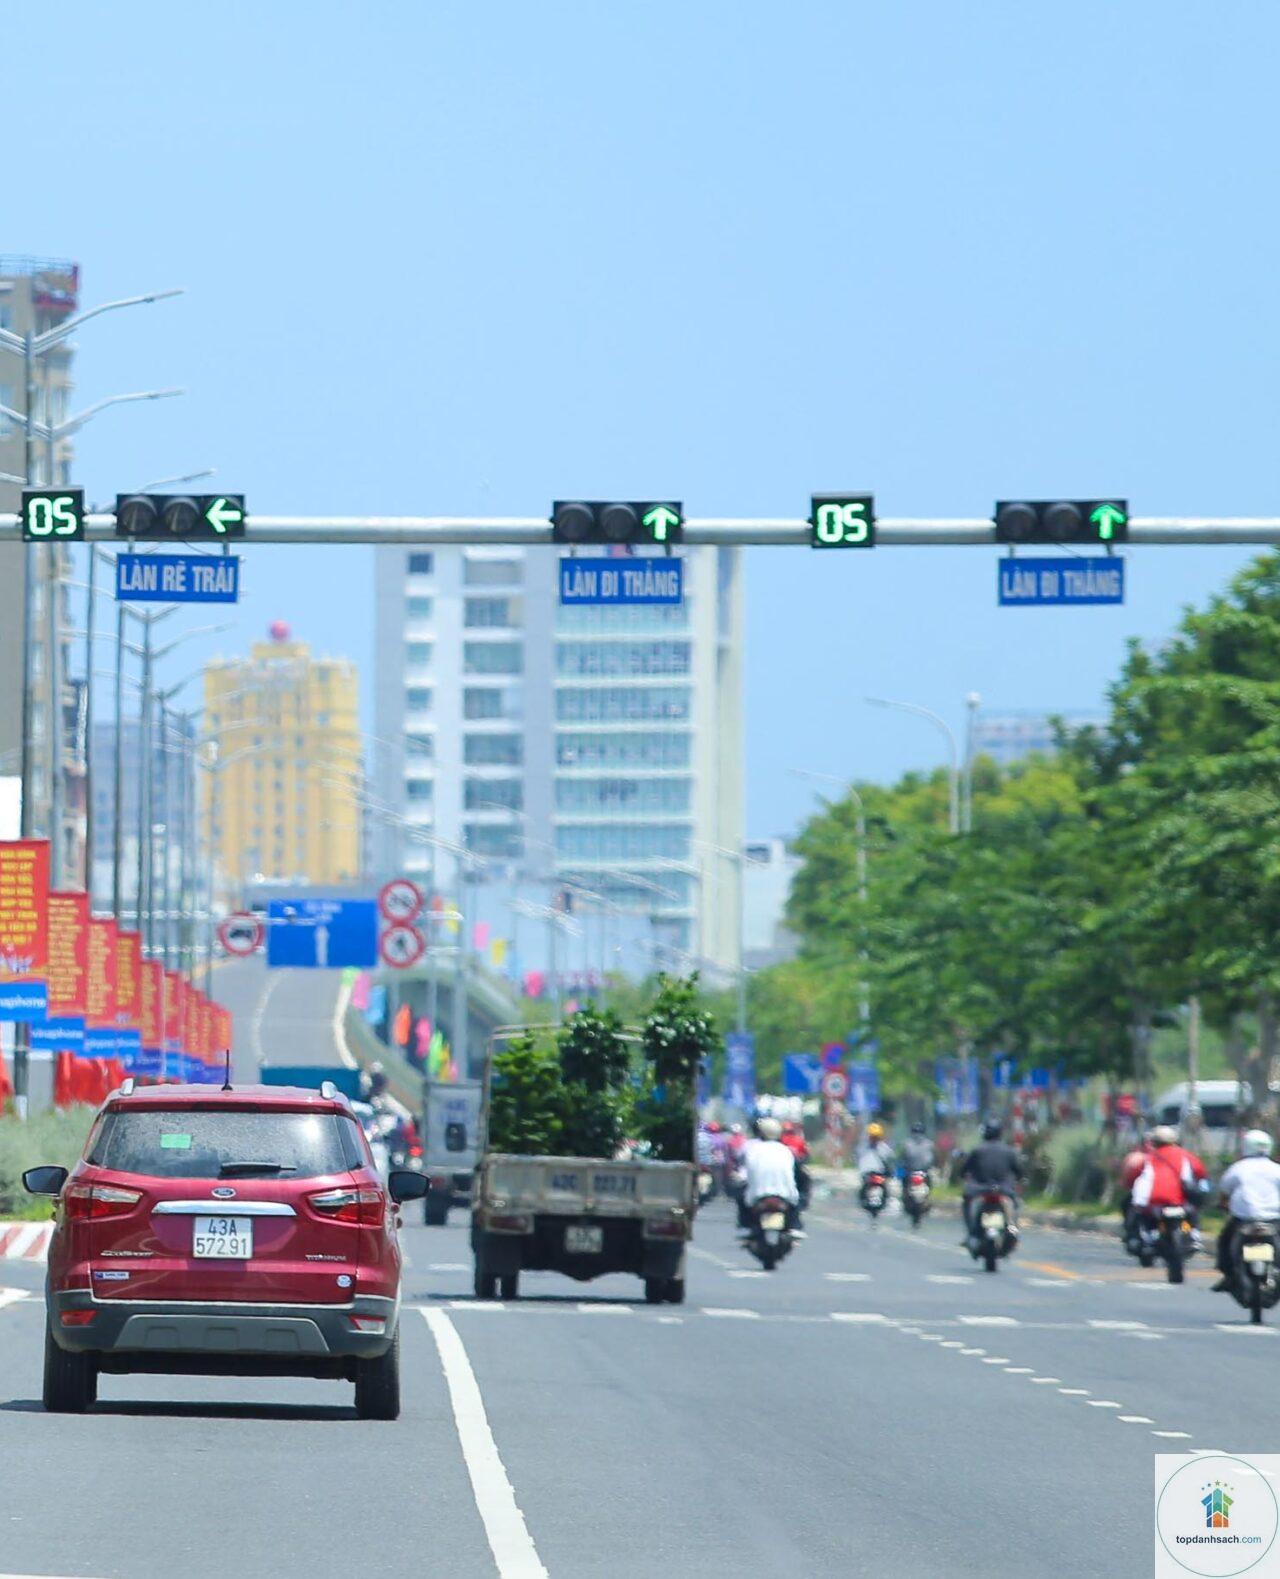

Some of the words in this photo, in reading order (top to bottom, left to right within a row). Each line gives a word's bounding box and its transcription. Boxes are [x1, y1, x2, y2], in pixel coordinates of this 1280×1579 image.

[28, 497, 77, 535] 05
[816, 503, 868, 542] 05
[121, 559, 157, 591] LÀN
[162, 560, 186, 592] RẼ
[192, 561, 234, 593] TRÁI
[564, 565, 597, 597] LÀN
[208, 1219, 237, 1236] 43A
[196, 1237, 247, 1256] 572.91
